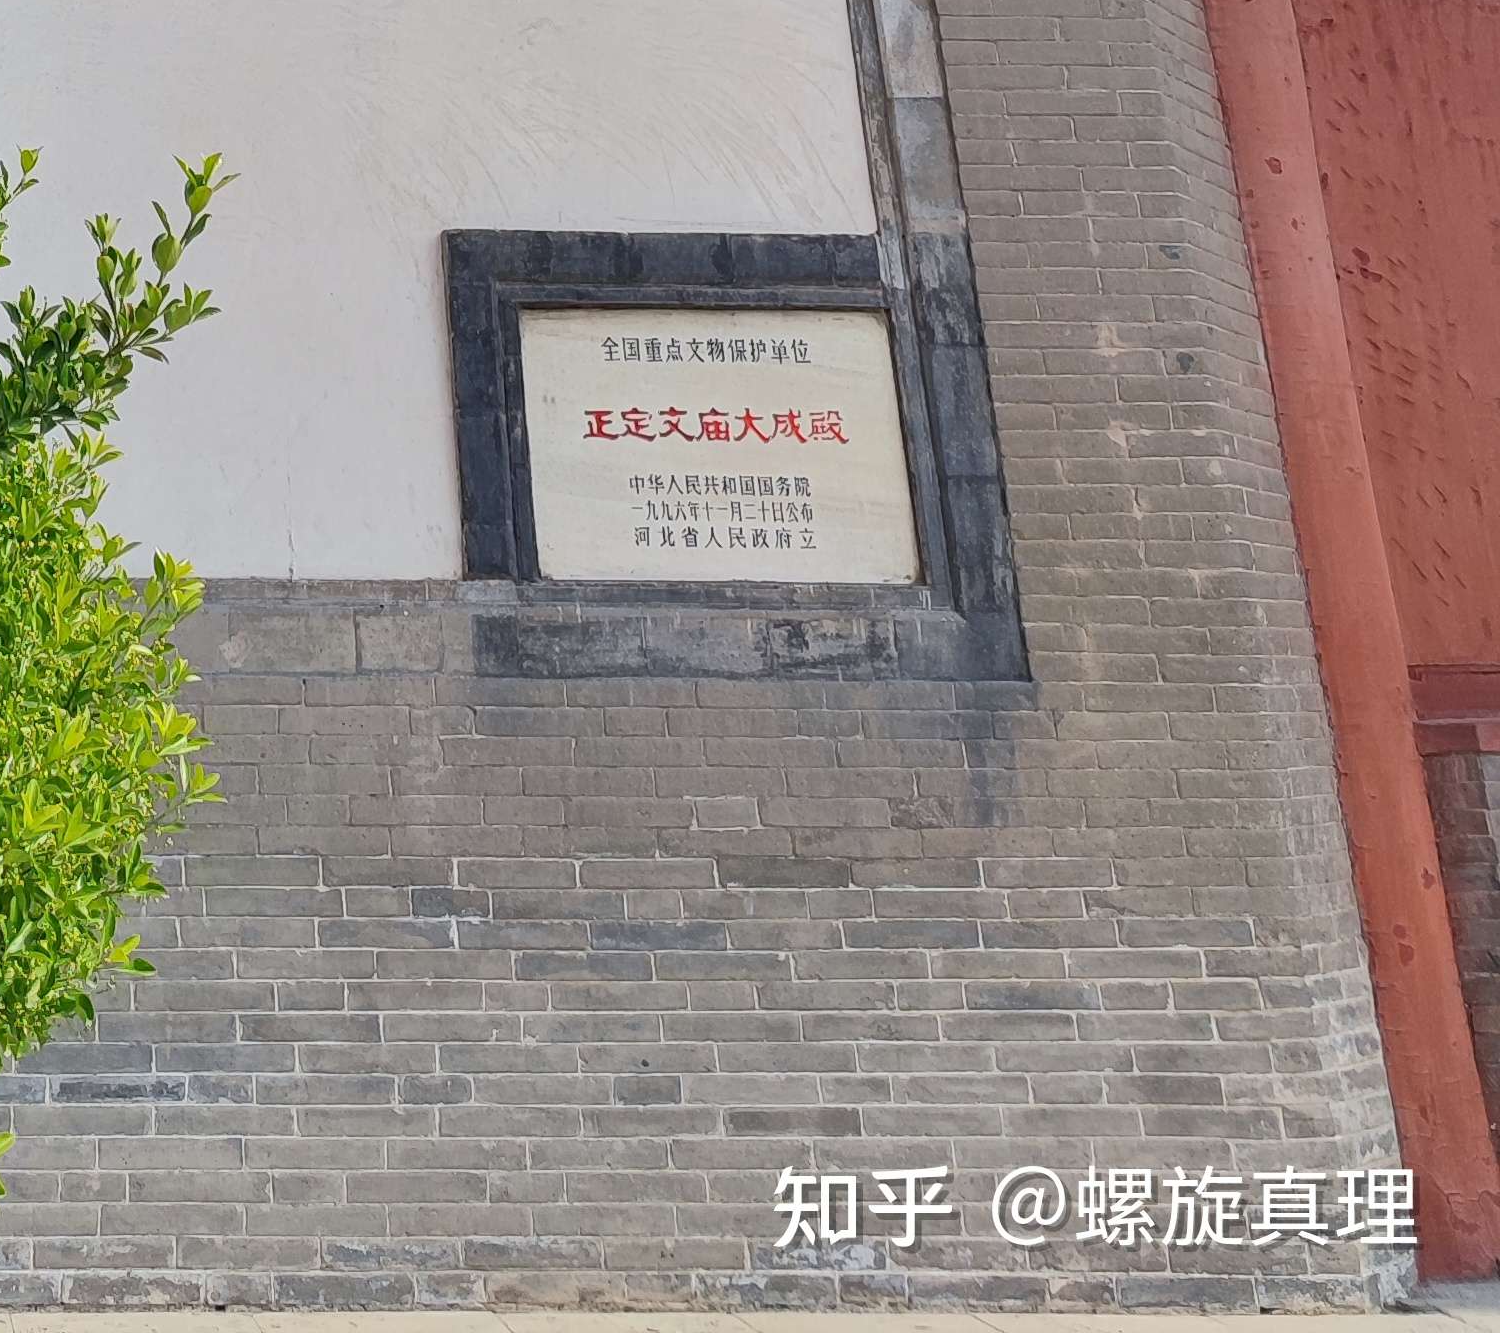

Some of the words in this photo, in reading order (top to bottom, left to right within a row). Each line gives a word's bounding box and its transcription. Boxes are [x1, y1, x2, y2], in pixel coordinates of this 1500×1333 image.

[601, 337, 812, 364] 全国重点文物保护单位
[583, 407, 850, 444] 正定文庙大成殿
[629, 474, 811, 497] 中华人民共和国国务院
[631, 500, 813, 523] 一九九六年十一月二十日公布
[634, 527, 817, 549] 河北省人民政府立
